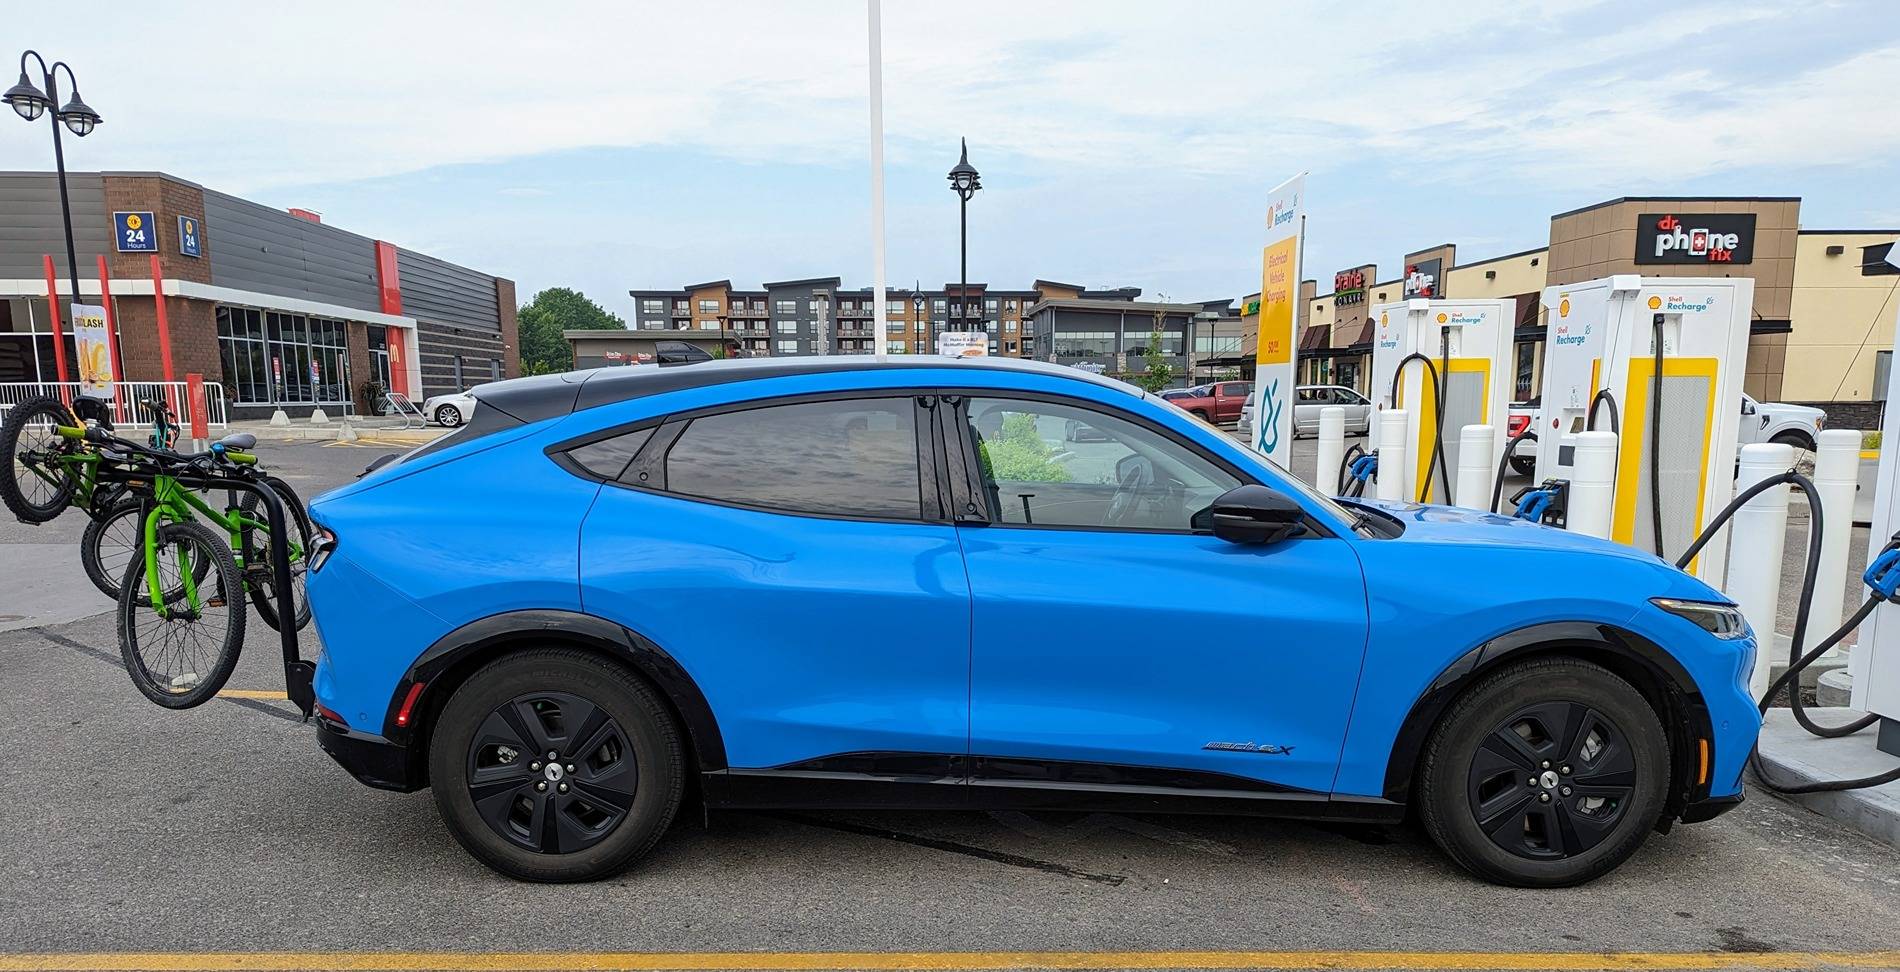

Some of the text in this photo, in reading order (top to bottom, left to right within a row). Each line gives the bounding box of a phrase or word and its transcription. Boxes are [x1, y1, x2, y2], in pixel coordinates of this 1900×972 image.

[1275, 209, 1294, 225] Recharge
[126, 229, 146, 243] 24
[186, 235, 196, 248] 24
[1269, 250, 1288, 268] Electrical
[1709, 248, 1732, 261] fix
[1269, 270, 1285, 284] Vehicle
[1267, 287, 1287, 303] Charging
[1667, 302, 1707, 312] Recharge
[1451, 317, 1481, 325] Recharge
[1557, 326, 1569, 334] Shell
[1556, 334, 1586, 346] Recharge
